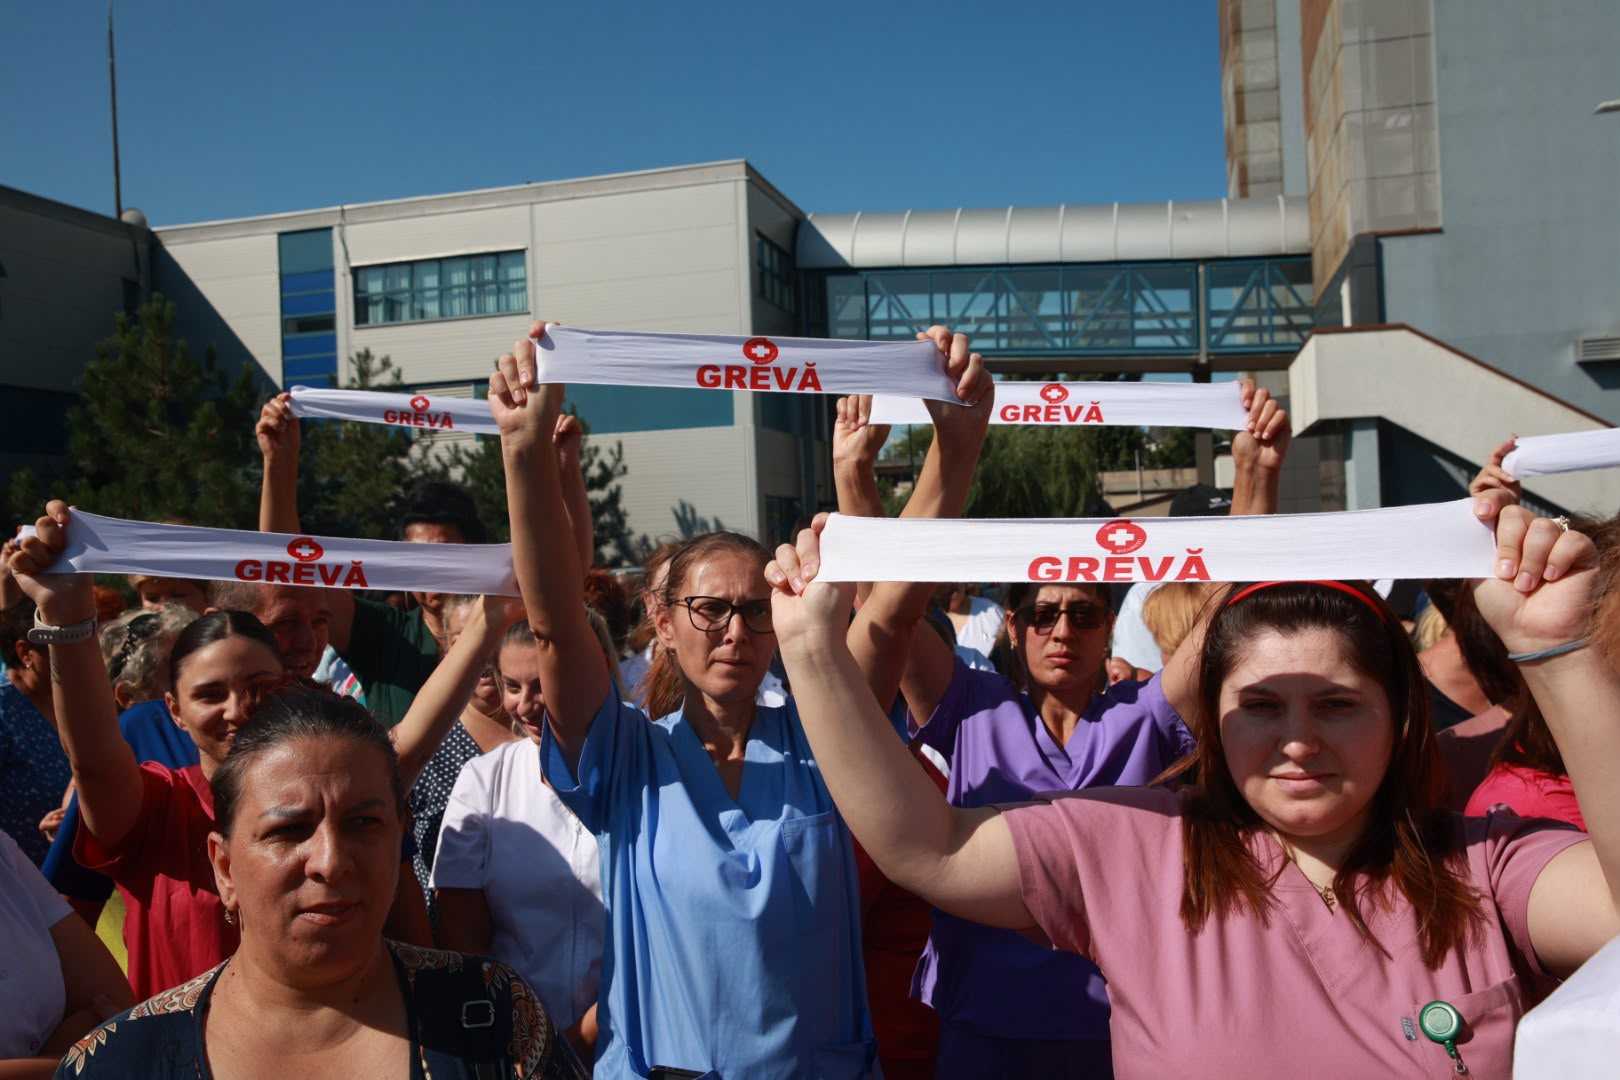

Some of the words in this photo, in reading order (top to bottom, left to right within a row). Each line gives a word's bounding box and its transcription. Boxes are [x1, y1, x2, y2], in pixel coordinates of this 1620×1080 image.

[696, 361, 822, 391] GREVĂ
[384, 409, 454, 429] GREVĂ
[1000, 401, 1104, 423] GREVĂ
[235, 559, 368, 588] GREVĂ
[1028, 548, 1211, 581] GREVĂ
